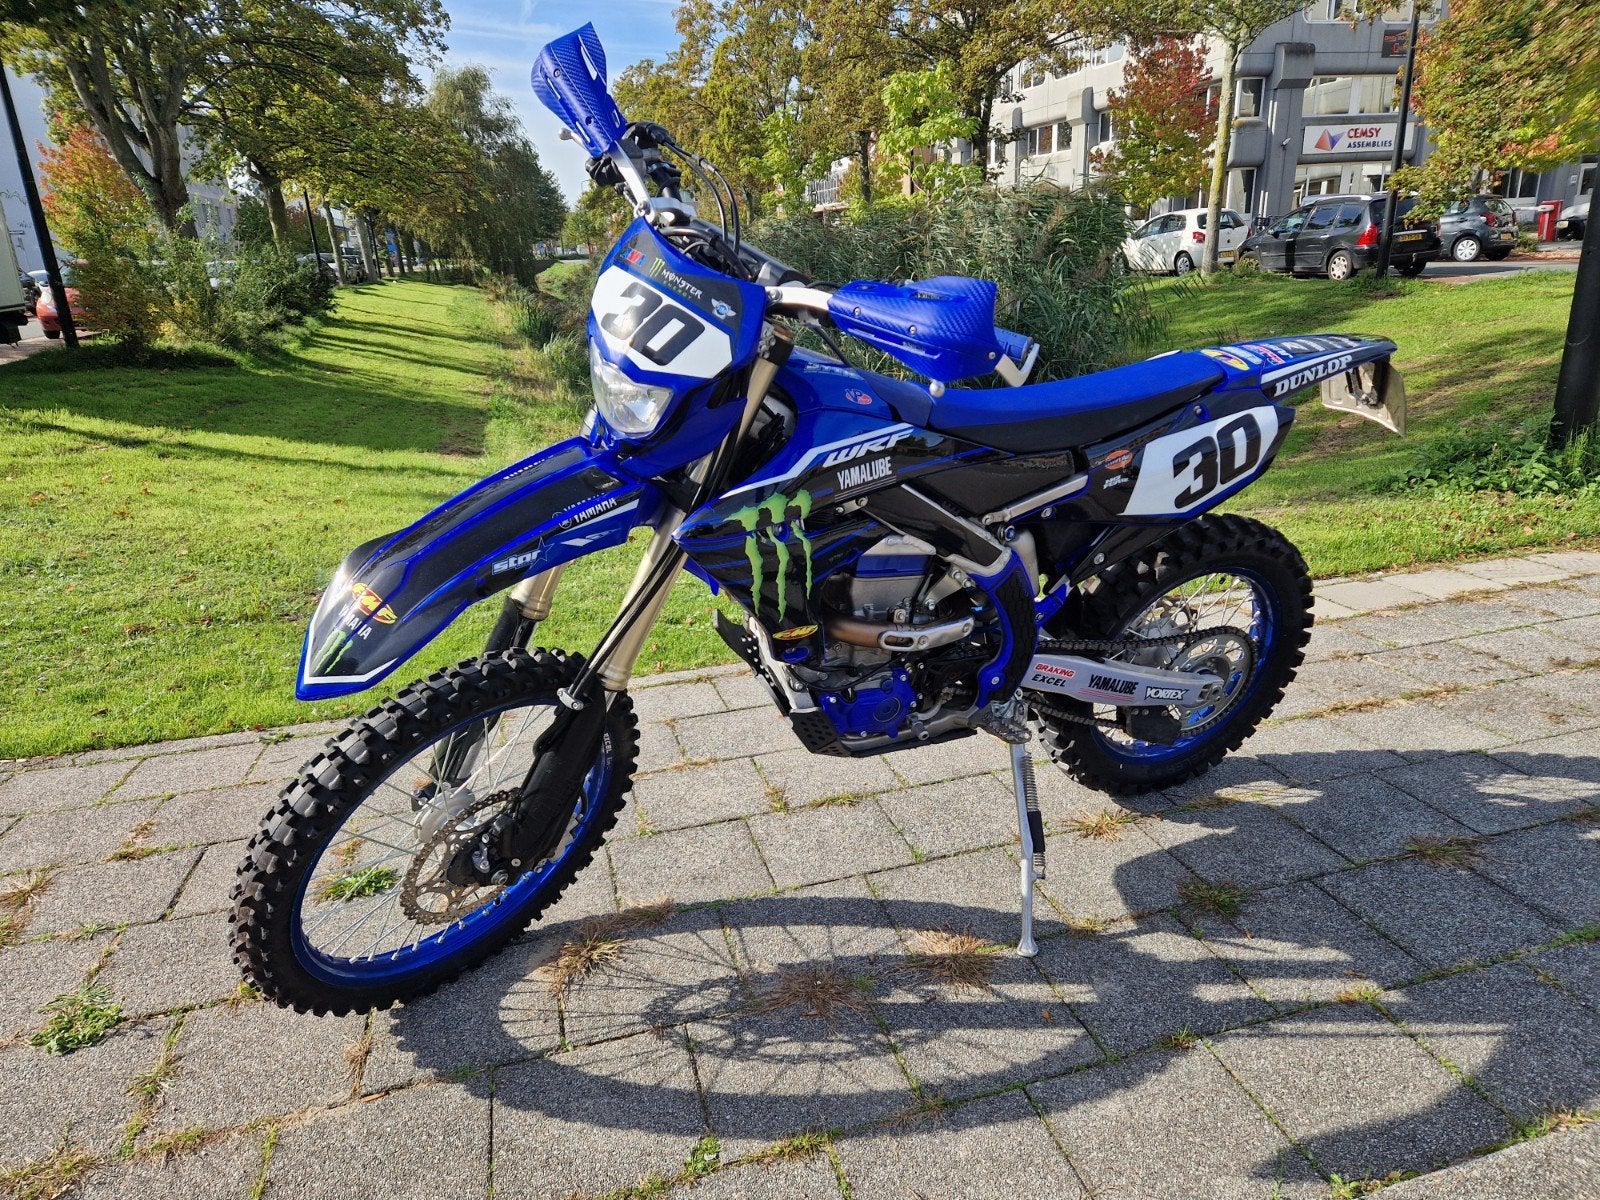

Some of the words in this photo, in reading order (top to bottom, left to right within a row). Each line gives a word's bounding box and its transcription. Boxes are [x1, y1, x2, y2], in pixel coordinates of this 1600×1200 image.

[1347, 128, 1381, 139] CEMSY
[1347, 140, 1392, 149] ASSEMBLIES
[661, 269, 703, 299] MONSTER
[601, 281, 706, 366] 30
[1274, 354, 1353, 397] DUNLOP
[822, 429, 914, 468] WRF
[1172, 413, 1261, 509] 30
[837, 456, 893, 490] YAMALUBE
[1031, 674, 1067, 687] EXCEL
[1035, 663, 1075, 678] BRAKING
[1088, 674, 1139, 695] YAMALUBE
[1145, 686, 1188, 700] VORTEX
